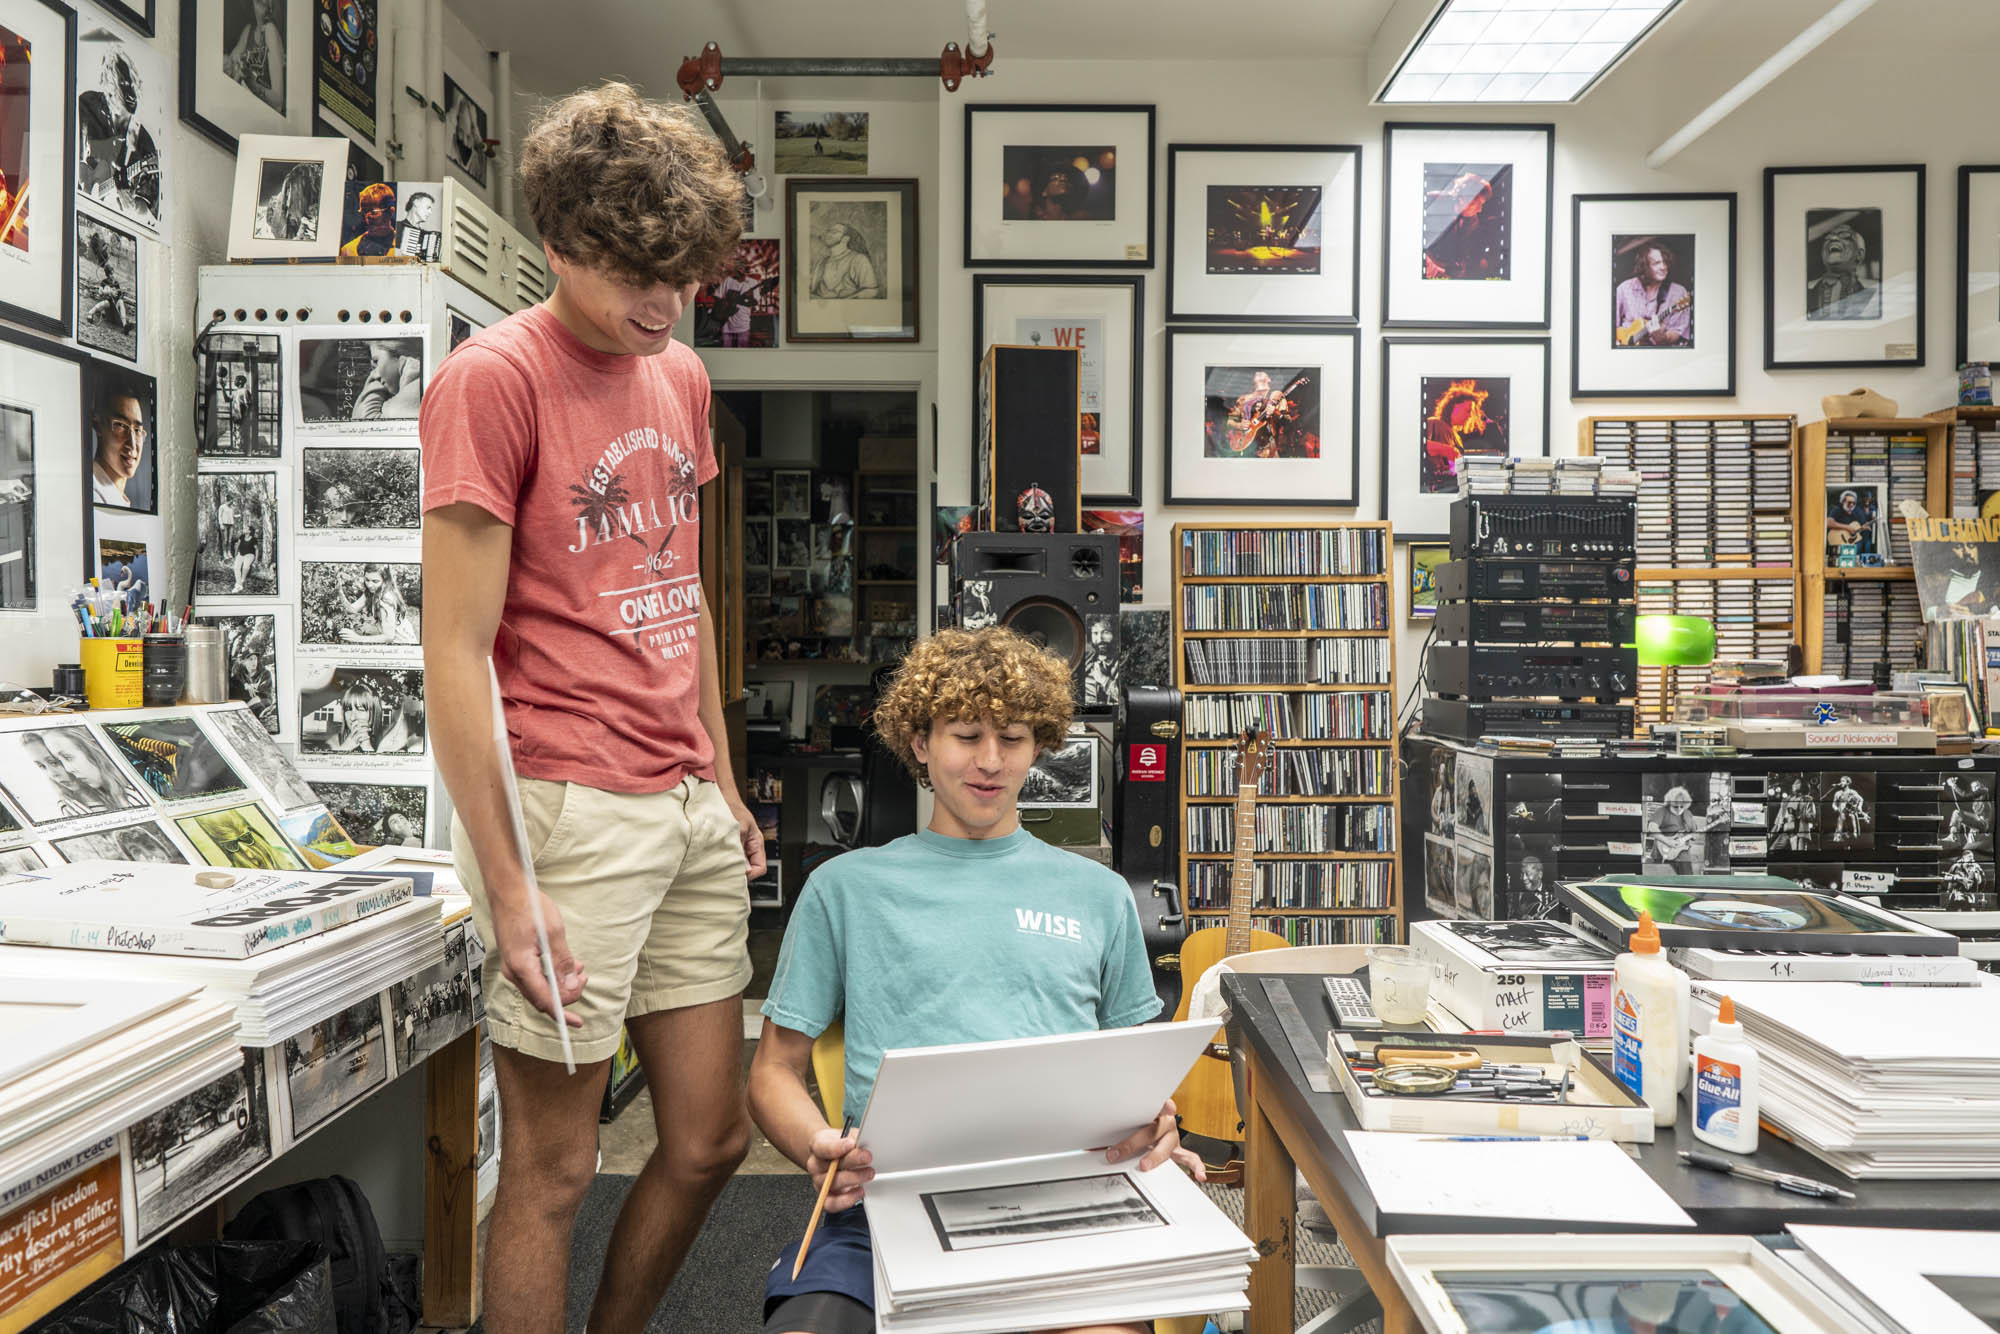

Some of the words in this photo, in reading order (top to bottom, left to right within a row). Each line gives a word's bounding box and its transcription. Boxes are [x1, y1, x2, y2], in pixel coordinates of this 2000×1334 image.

[1054, 327, 1086, 349] WE
[567, 492, 699, 553] JAMAIC
[1905, 517, 2000, 543] BUCHANA
[191, 876, 395, 927] ILFORD
[107, 926, 156, 950] Photoshop
[1015, 907, 1082, 940] WISE
[1497, 974, 1526, 985] 250
[1698, 1077, 1741, 1101] Glue-All
[0, 1207, 49, 1246] acrifice
[50, 1180, 98, 1227] freedom
[0, 1250, 24, 1276] rity
[25, 1222, 72, 1261] deserve
[73, 1197, 118, 1231] neither.
